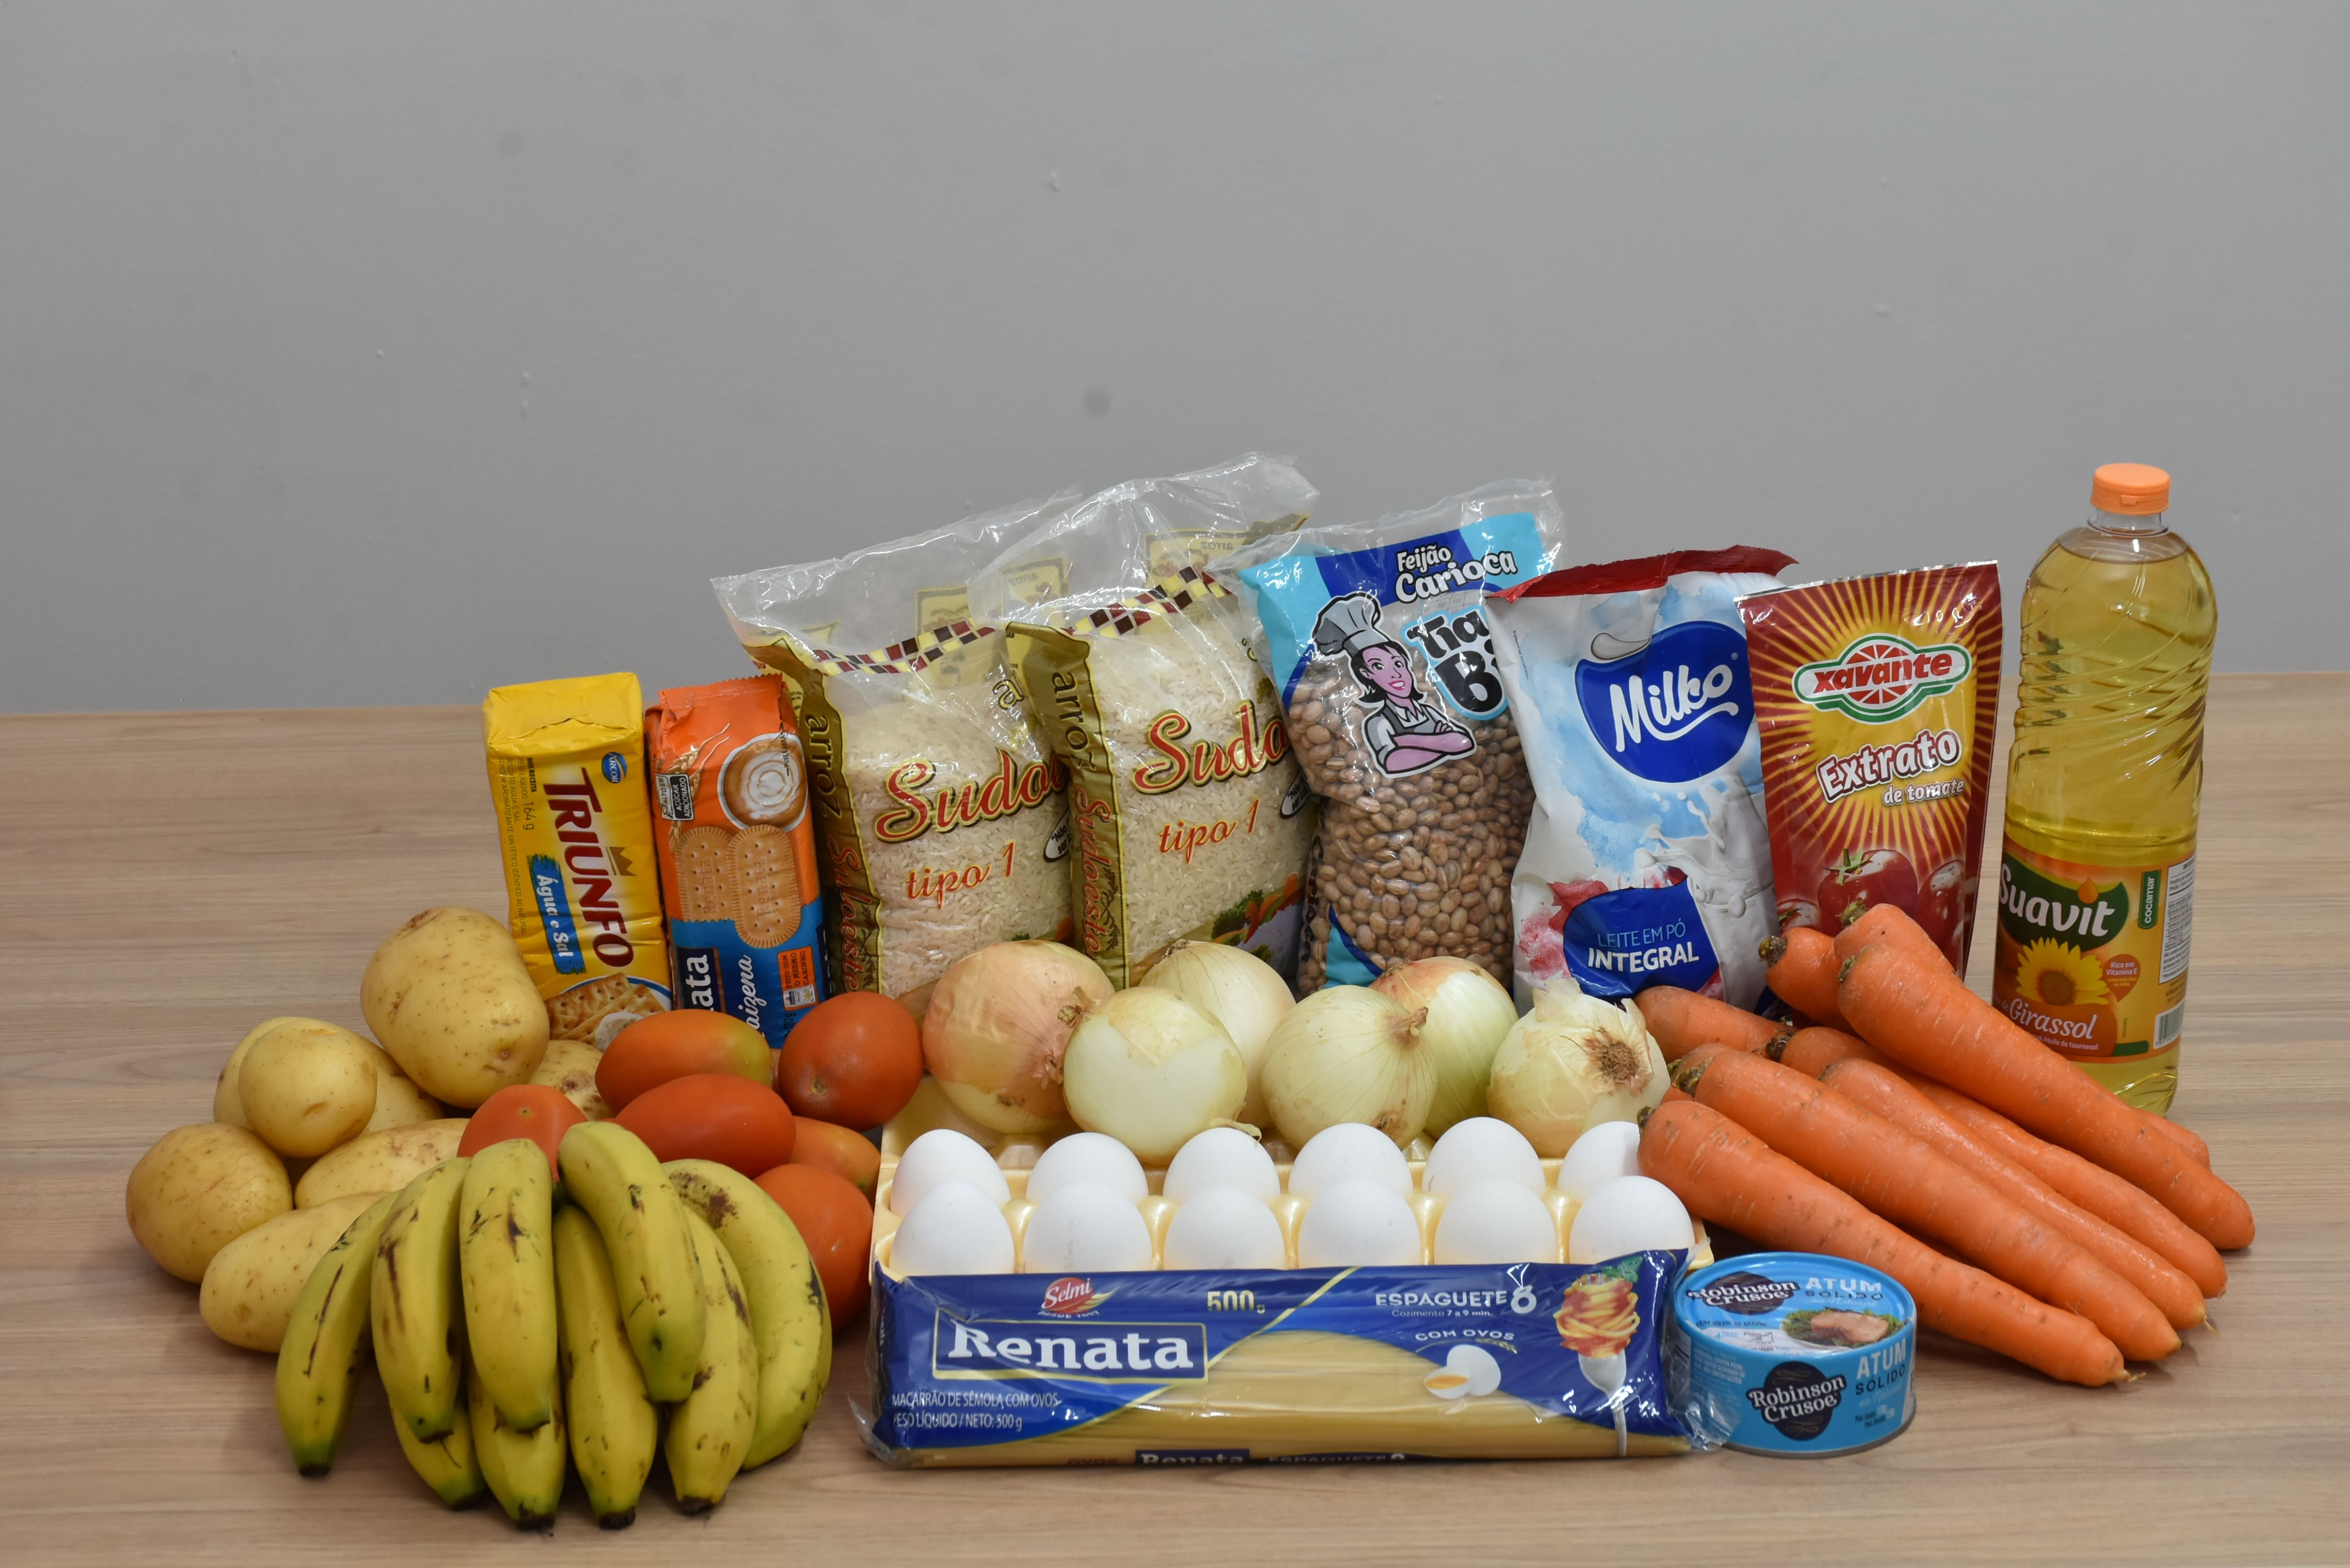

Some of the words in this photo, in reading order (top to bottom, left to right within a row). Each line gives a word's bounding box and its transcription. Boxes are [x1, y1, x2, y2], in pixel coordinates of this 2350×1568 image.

[1397, 544, 1452, 573] Feijão
[1395, 551, 1517, 604] Carioca
[1407, 610, 1490, 659] Tia
[1813, 653, 1952, 694] xavante
[1610, 664, 1733, 753] Milko
[528, 769, 537, 792] RECEITA
[608, 753, 619, 783] ARCOR
[805, 713, 842, 820] arroz
[1817, 730, 1960, 801] Extrato
[519, 774, 527, 799] LÍQUIDO
[524, 801, 536, 821] 164
[660, 788, 668, 804] ALTO
[679, 777, 690, 817] ADICIONADO
[1883, 786, 1903, 805] de
[1906, 778, 1965, 802] tomate
[502, 786, 513, 833] AROMATIZANTE
[1159, 819, 1238, 864] tipo
[1247, 797, 1260, 833] 1
[508, 834, 518, 868] SINTÉTICO
[543, 767, 634, 967] TRIUNFO
[512, 869, 522, 896] IDÊNTICO
[701, 860, 718, 914] Renata
[906, 863, 992, 909] tipo
[1003, 839, 1015, 878] 1
[1075, 786, 1113, 960] Sudoeste
[536, 874, 559, 917] Água
[1999, 863, 2115, 937] Suavit
[2145, 877, 2155, 924] cocamar
[517, 907, 526, 934] NATURAL
[550, 920, 560, 928] e
[1597, 930, 1640, 948] LEITE
[1643, 926, 1663, 944] EM
[1667, 918, 1686, 940] PÓ
[553, 932, 573, 957] Sal
[1588, 941, 1699, 972] INTEGRAL
[790, 953, 800, 979] MESMO
[800, 951, 809, 985] CARINHO
[738, 955, 767, 1034] aizena
[2010, 998, 2097, 1040] Girassol
[2069, 1042, 2099, 1051] tournesol
[1041, 1277, 1092, 1310] Selmi
[1375, 1290, 1507, 1307] ESPAGUETE
[1707, 1290, 1789, 1305] Crusoe
[1805, 1277, 1882, 1292] ATUM
[948, 1319, 1194, 1370] Renata
[1415, 1330, 1457, 1341] COM
[1462, 1329, 1515, 1340] OVOS
[1857, 1338, 1906, 1380] ATUM
[1749, 1377, 1845, 1407] Robinson
[1856, 1364, 1905, 1396] SÓLIDO
[892, 1390, 946, 1409] MAÇARRÃO
[948, 1393, 961, 1406] DE
[963, 1390, 1003, 1406] SÊMOLA
[1006, 1393, 1029, 1407] COM
[1765, 1394, 1837, 1422] Crusoe
[893, 1413, 914, 1427] PESO
[916, 1411, 958, 1429] LÍQUIDO
[959, 1413, 964, 1428] /
[966, 1413, 994, 1428] NETO:
[997, 1414, 1015, 1428] 500
[1016, 1417, 1022, 1432] g
